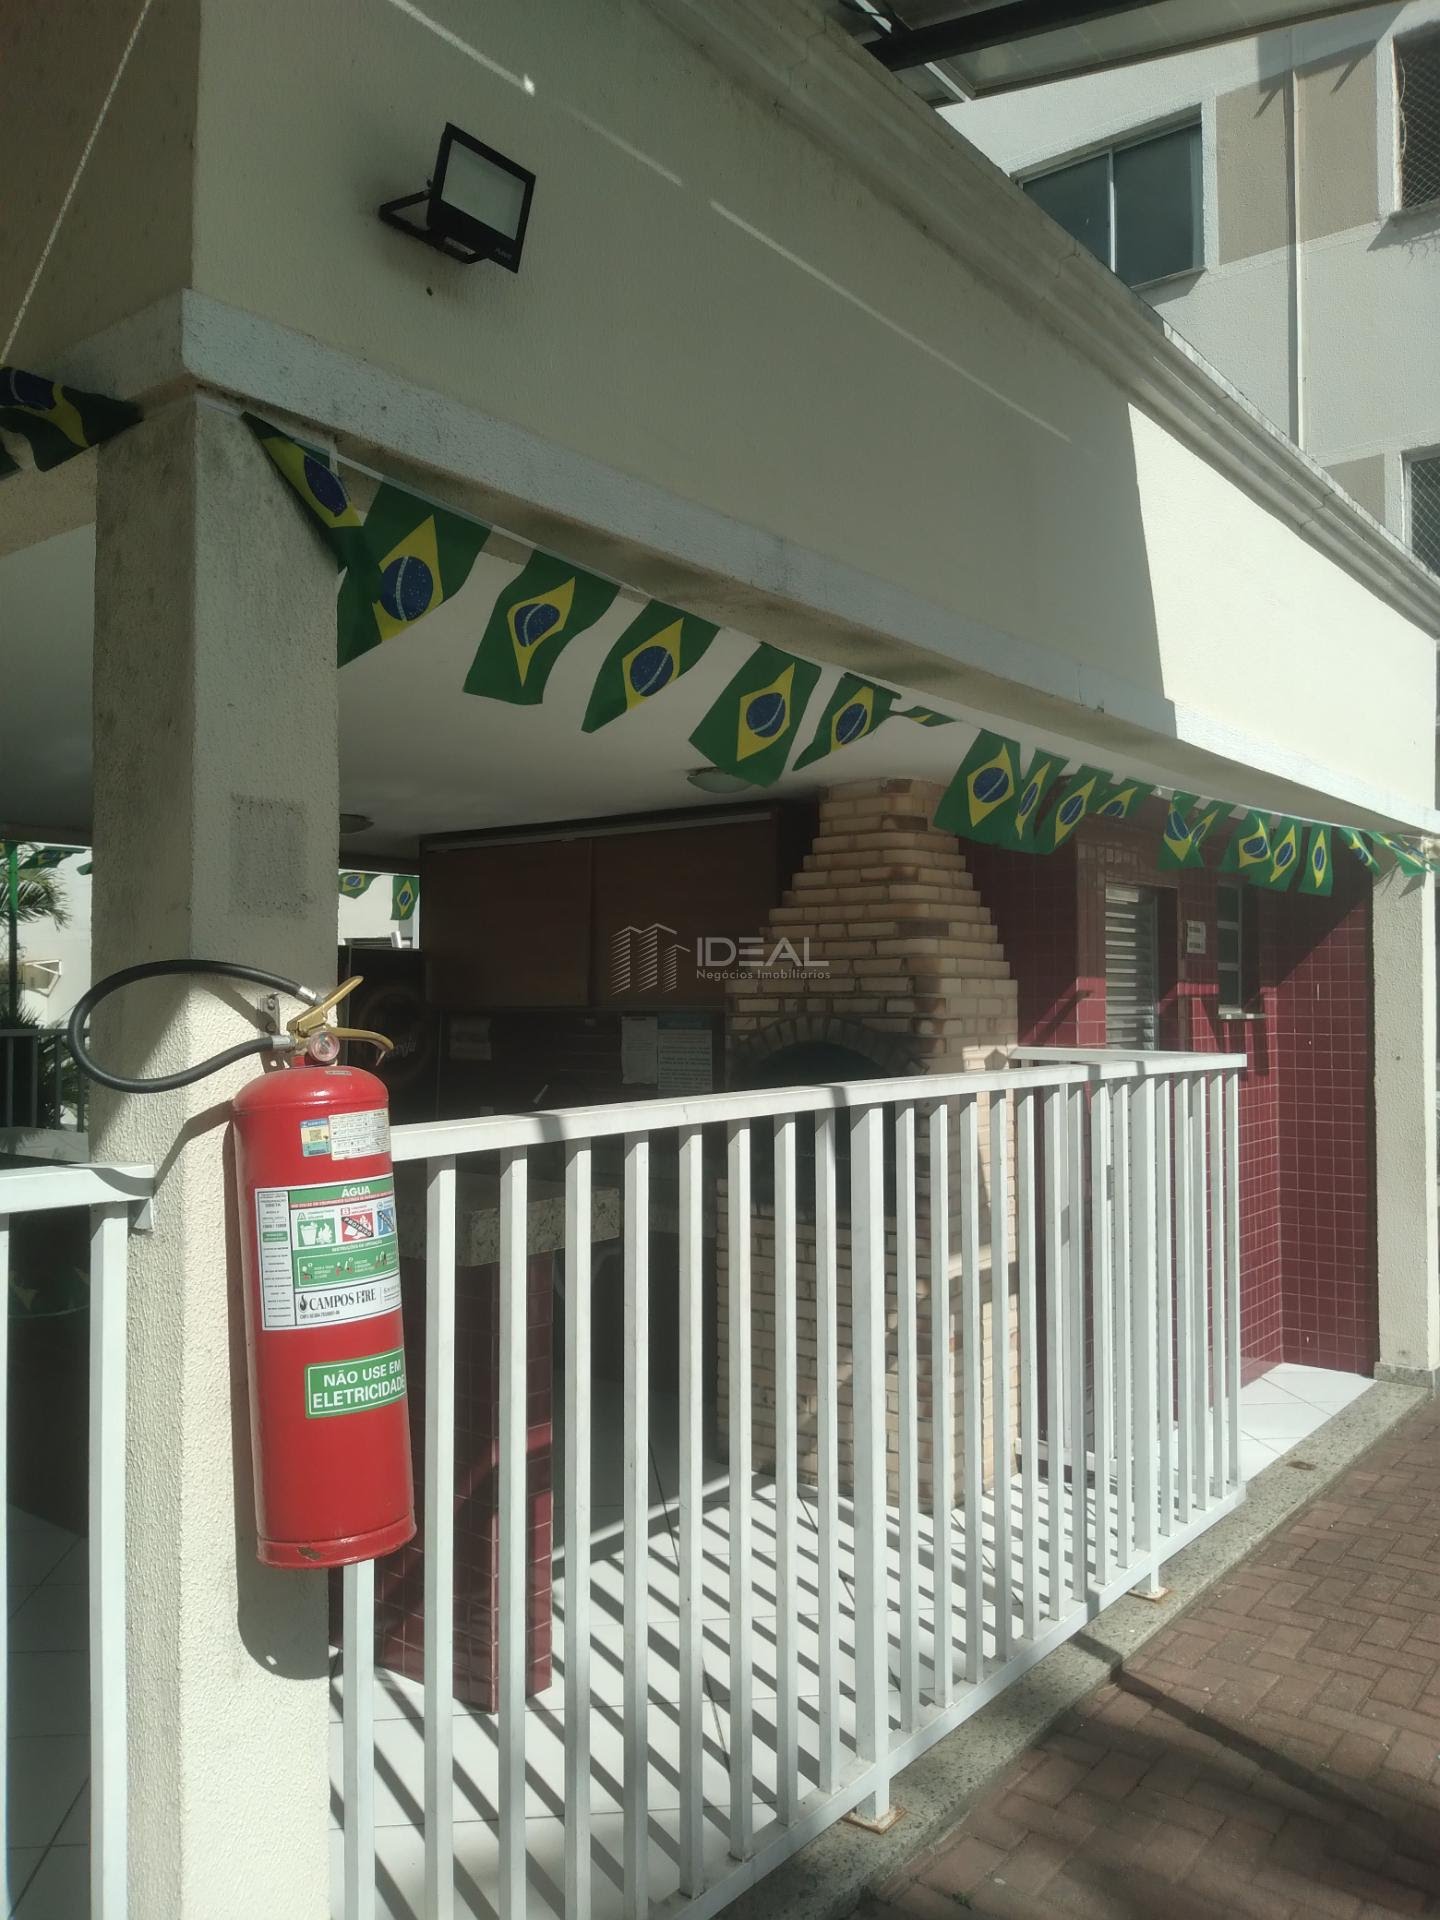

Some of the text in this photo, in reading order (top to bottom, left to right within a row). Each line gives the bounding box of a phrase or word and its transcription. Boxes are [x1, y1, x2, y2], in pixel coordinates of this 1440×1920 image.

[341, 1185, 371, 1198] ÁGUA
[309, 1293, 355, 1311] CAMPOS
[323, 1359, 401, 1387] NÃO USE EM
[313, 1375, 405, 1409] ELETRICIDADE
